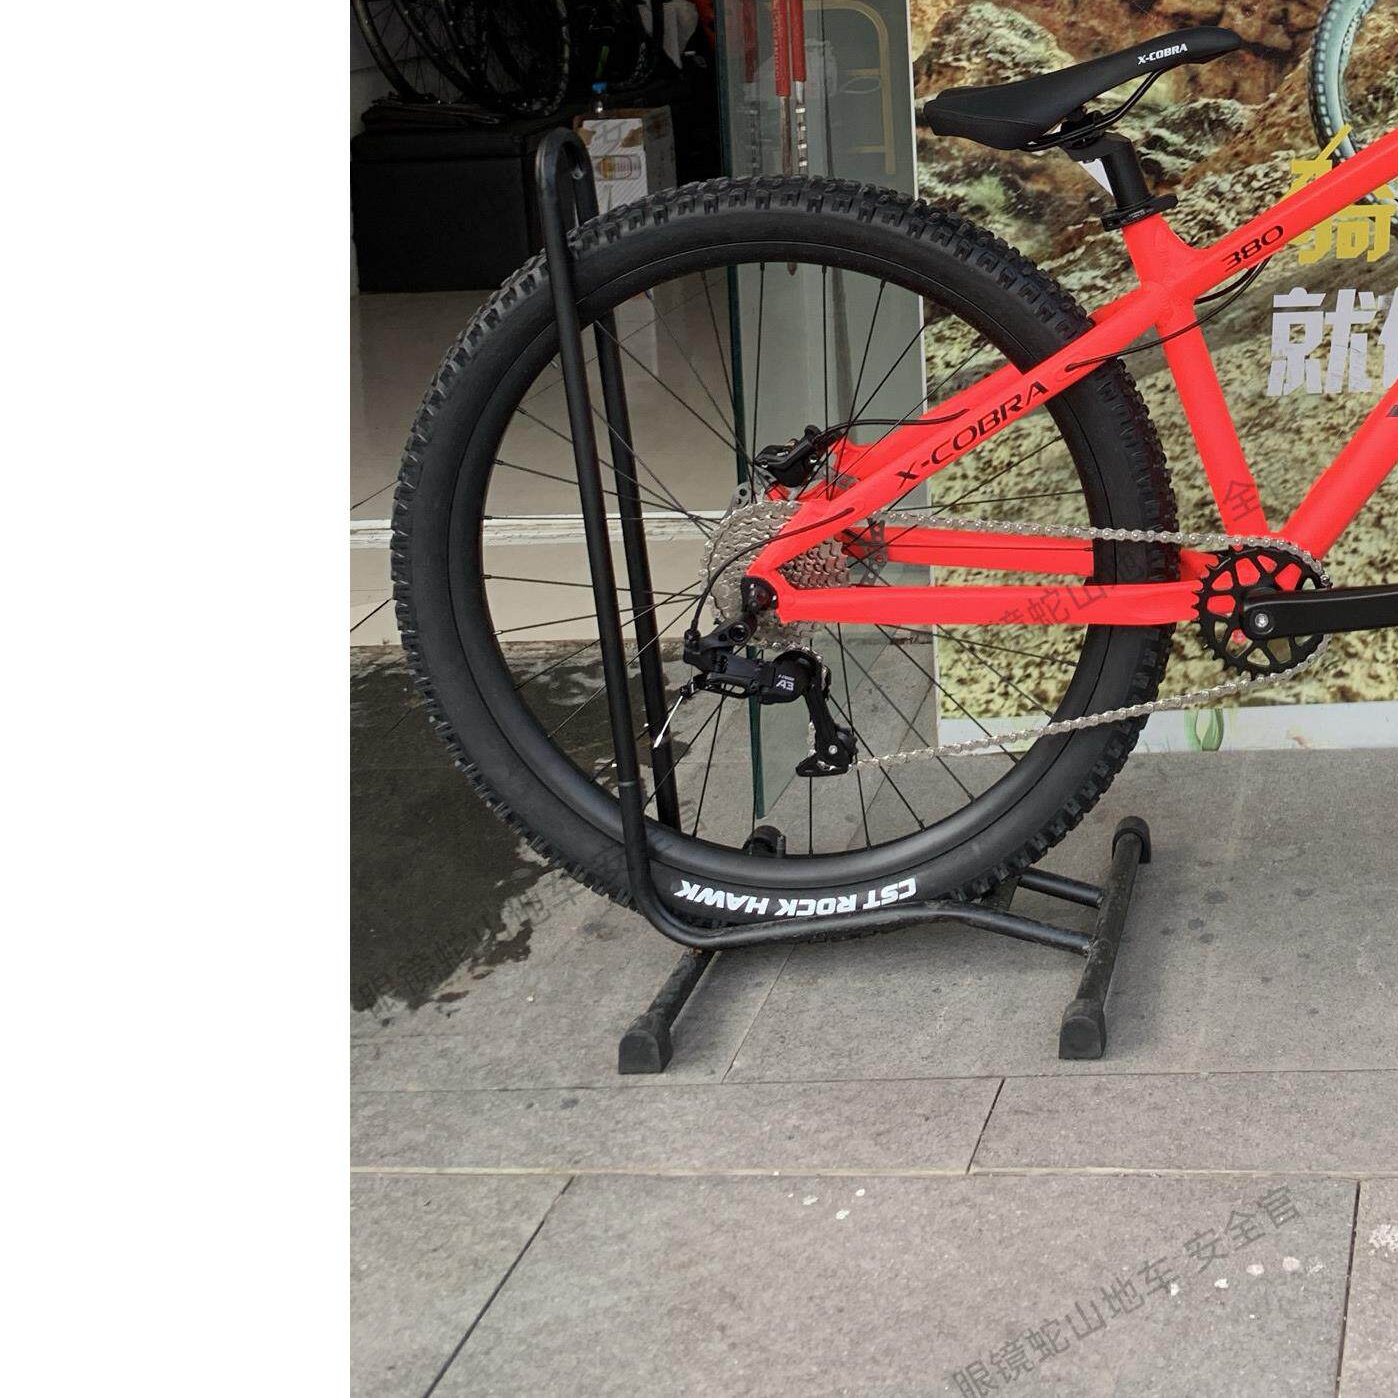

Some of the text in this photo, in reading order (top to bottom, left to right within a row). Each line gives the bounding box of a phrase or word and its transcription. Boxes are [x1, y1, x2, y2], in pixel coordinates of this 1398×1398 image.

[1137, 43, 1188, 65] X-COBRA
[1221, 224, 1285, 273] 380
[894, 380, 1050, 490] X-COBRA
[673, 877, 917, 917] CST ROCK HAWK
